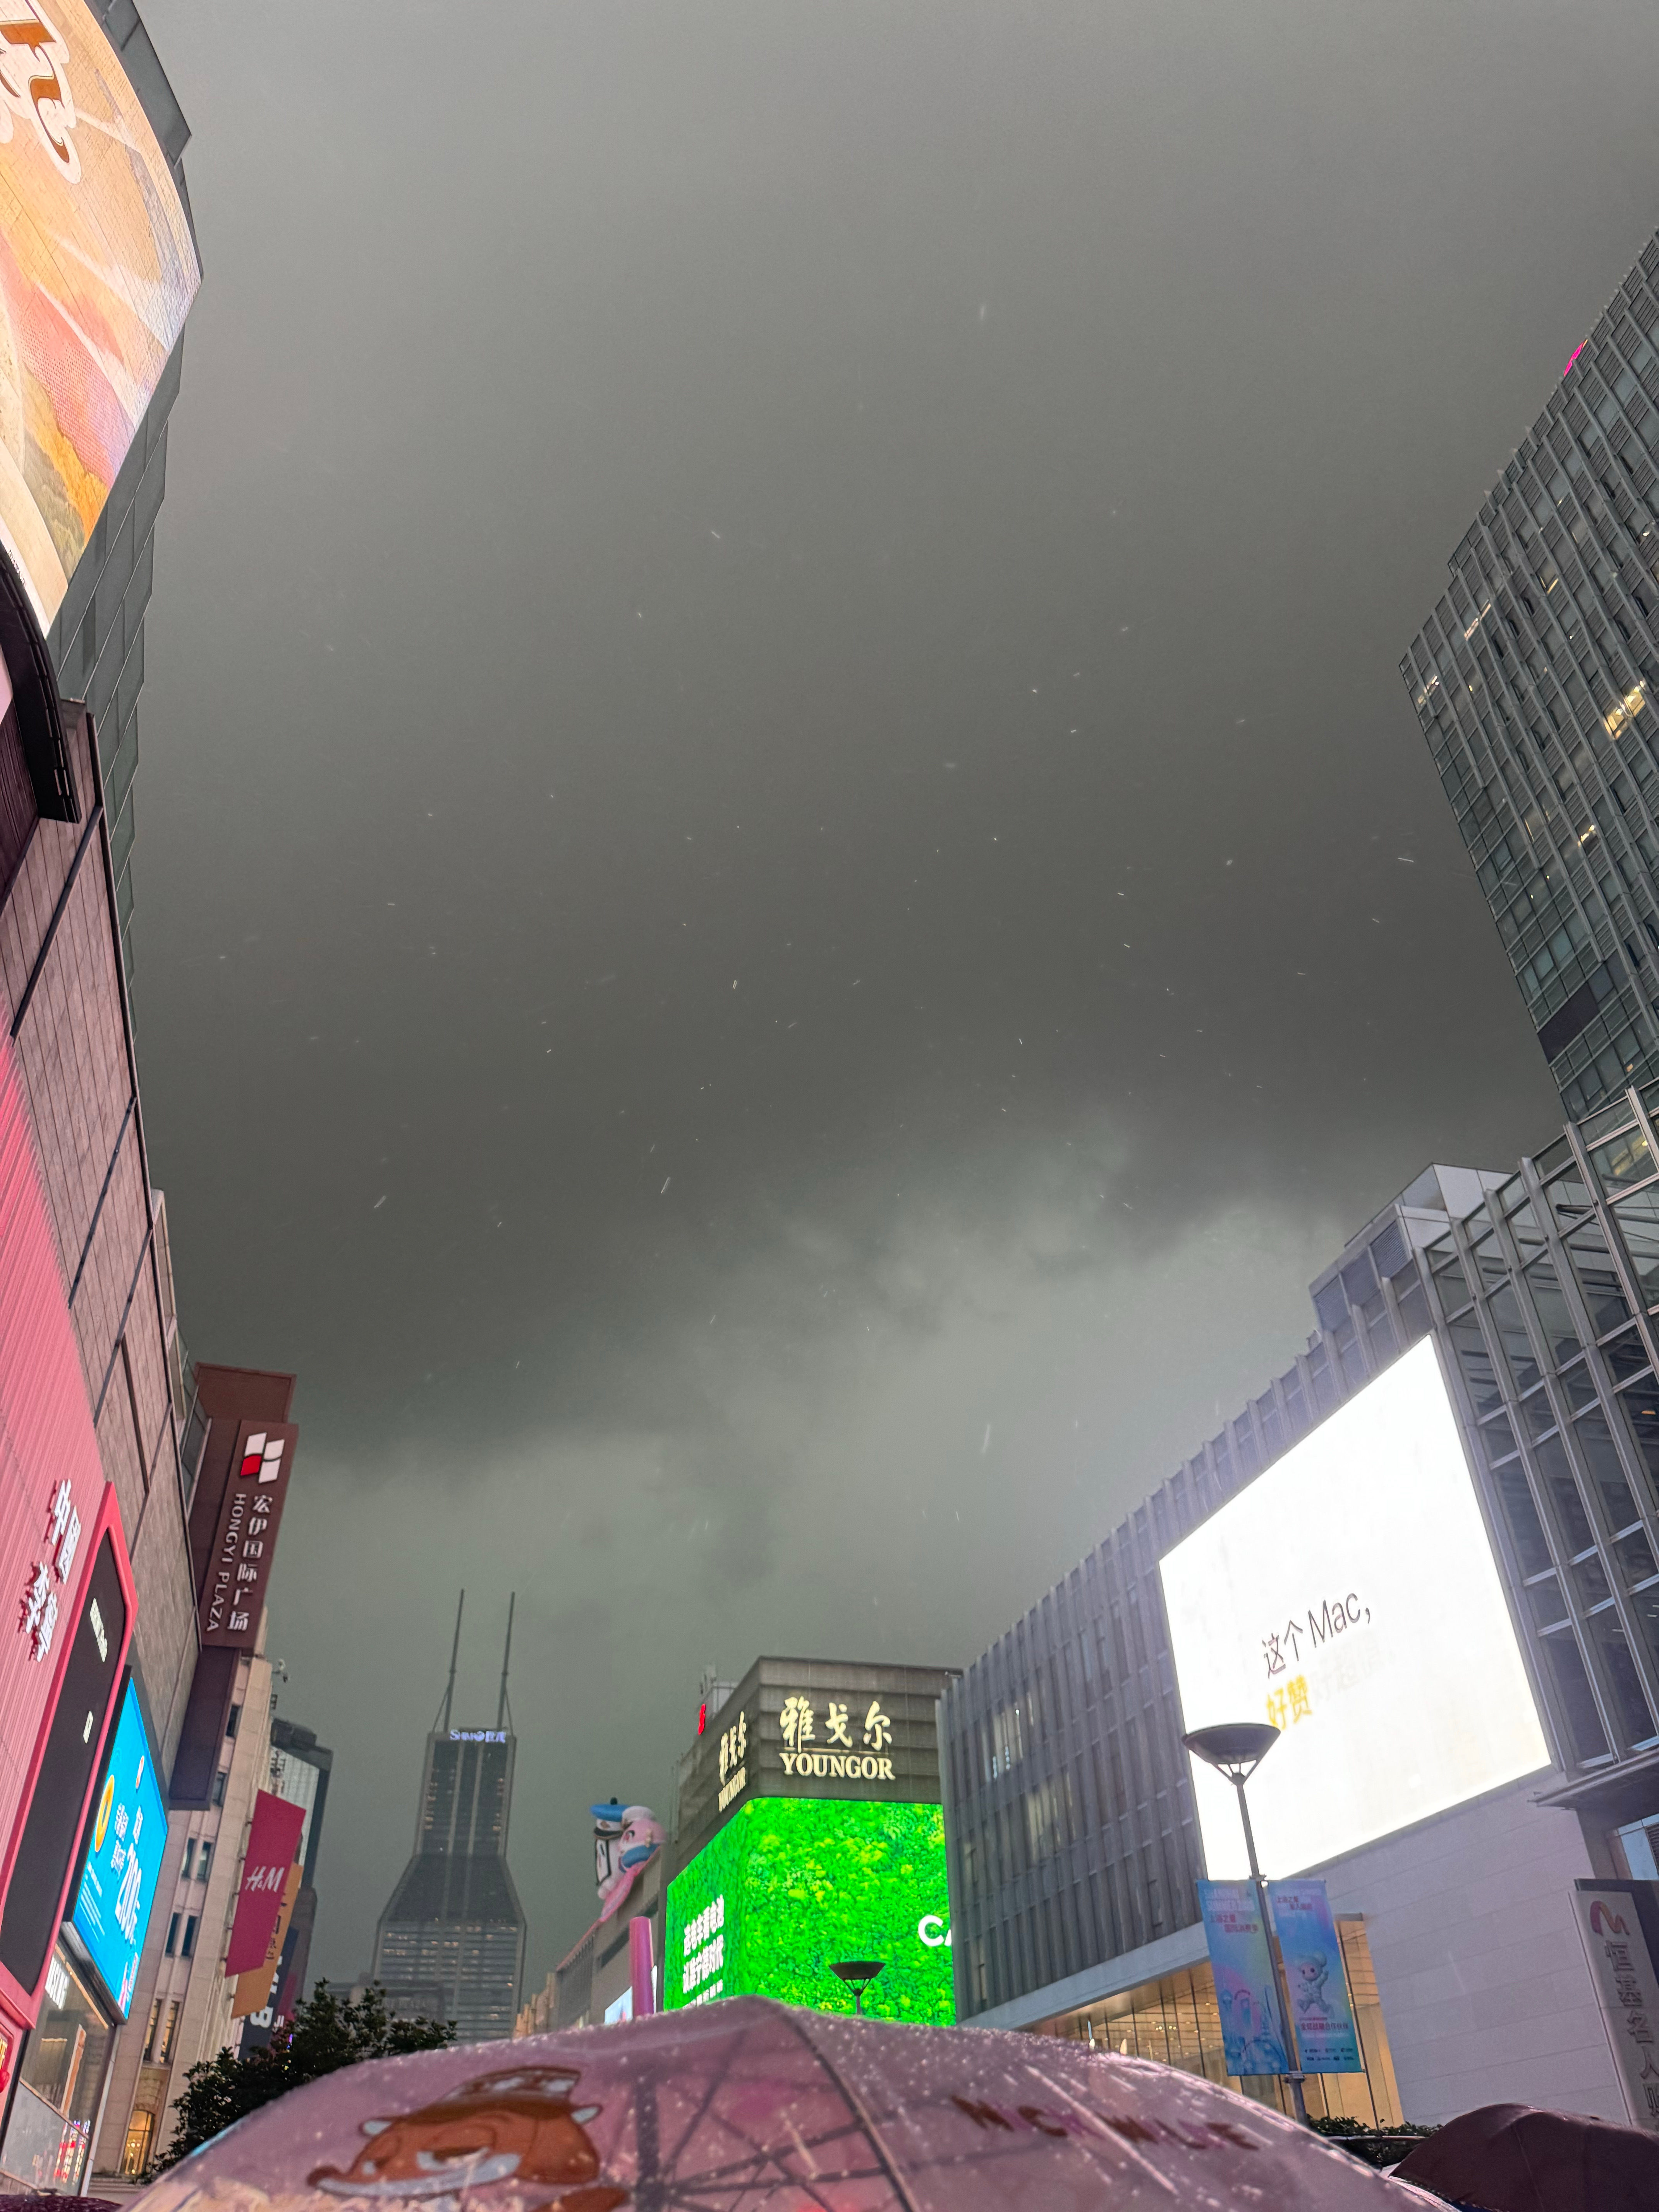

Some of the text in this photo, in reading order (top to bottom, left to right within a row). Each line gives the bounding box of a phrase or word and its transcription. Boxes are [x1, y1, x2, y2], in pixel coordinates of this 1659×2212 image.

[206, 1493, 247, 1631] HONGYI PLAZA
[227, 1495, 273, 1631] 宏伊国际广场
[1261, 1619, 1303, 1680] 这个
[780, 1696, 892, 1752] 雅戈尔
[1265, 1674, 1313, 1731] 好赞
[779, 1753, 896, 1780] YOUNGOR
[245, 1865, 285, 1892] H&M
